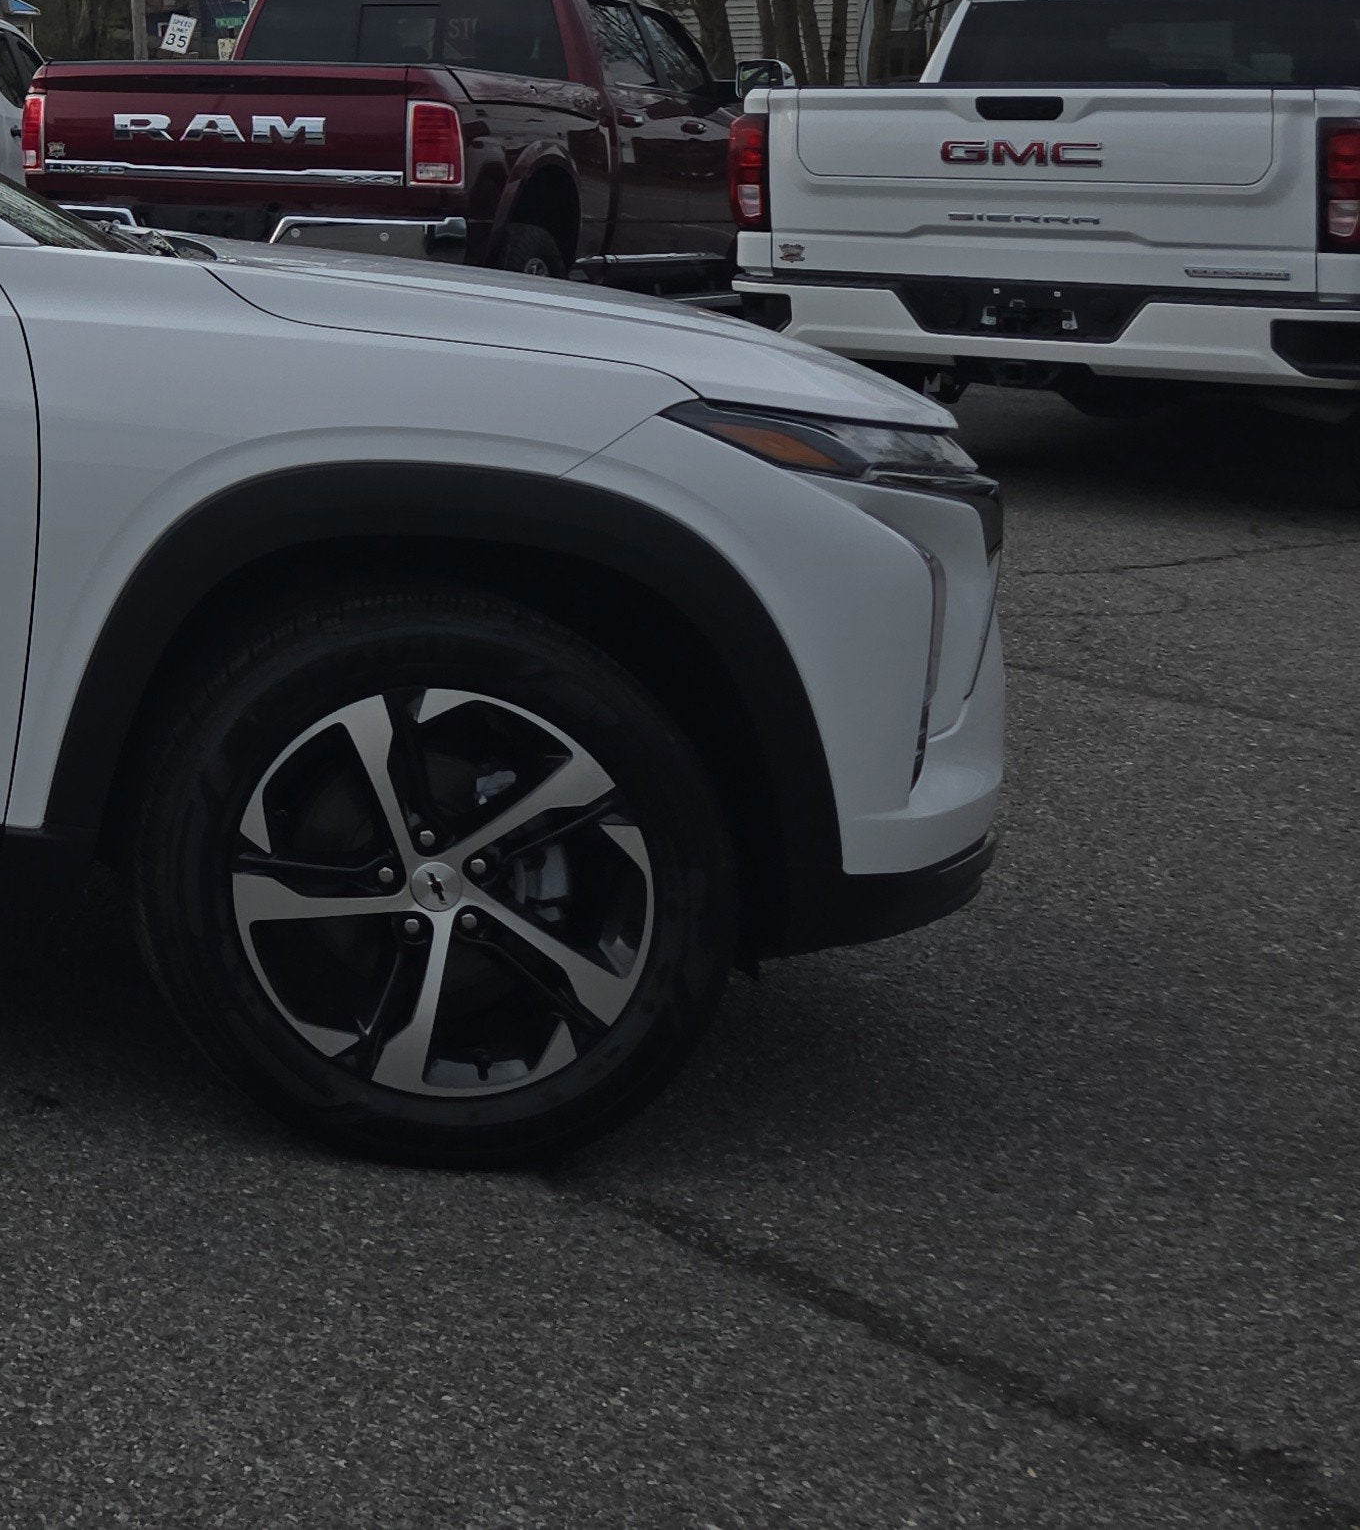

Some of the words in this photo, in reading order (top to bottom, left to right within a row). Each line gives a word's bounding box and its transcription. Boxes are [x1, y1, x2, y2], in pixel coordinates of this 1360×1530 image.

[172, 19, 192, 28] SPEED
[165, 33, 188, 48] 35
[113, 113, 327, 145] RAM
[940, 139, 1103, 168] GMC
[48, 164, 125, 174] LIMITED
[947, 211, 1100, 224] SIERRA
